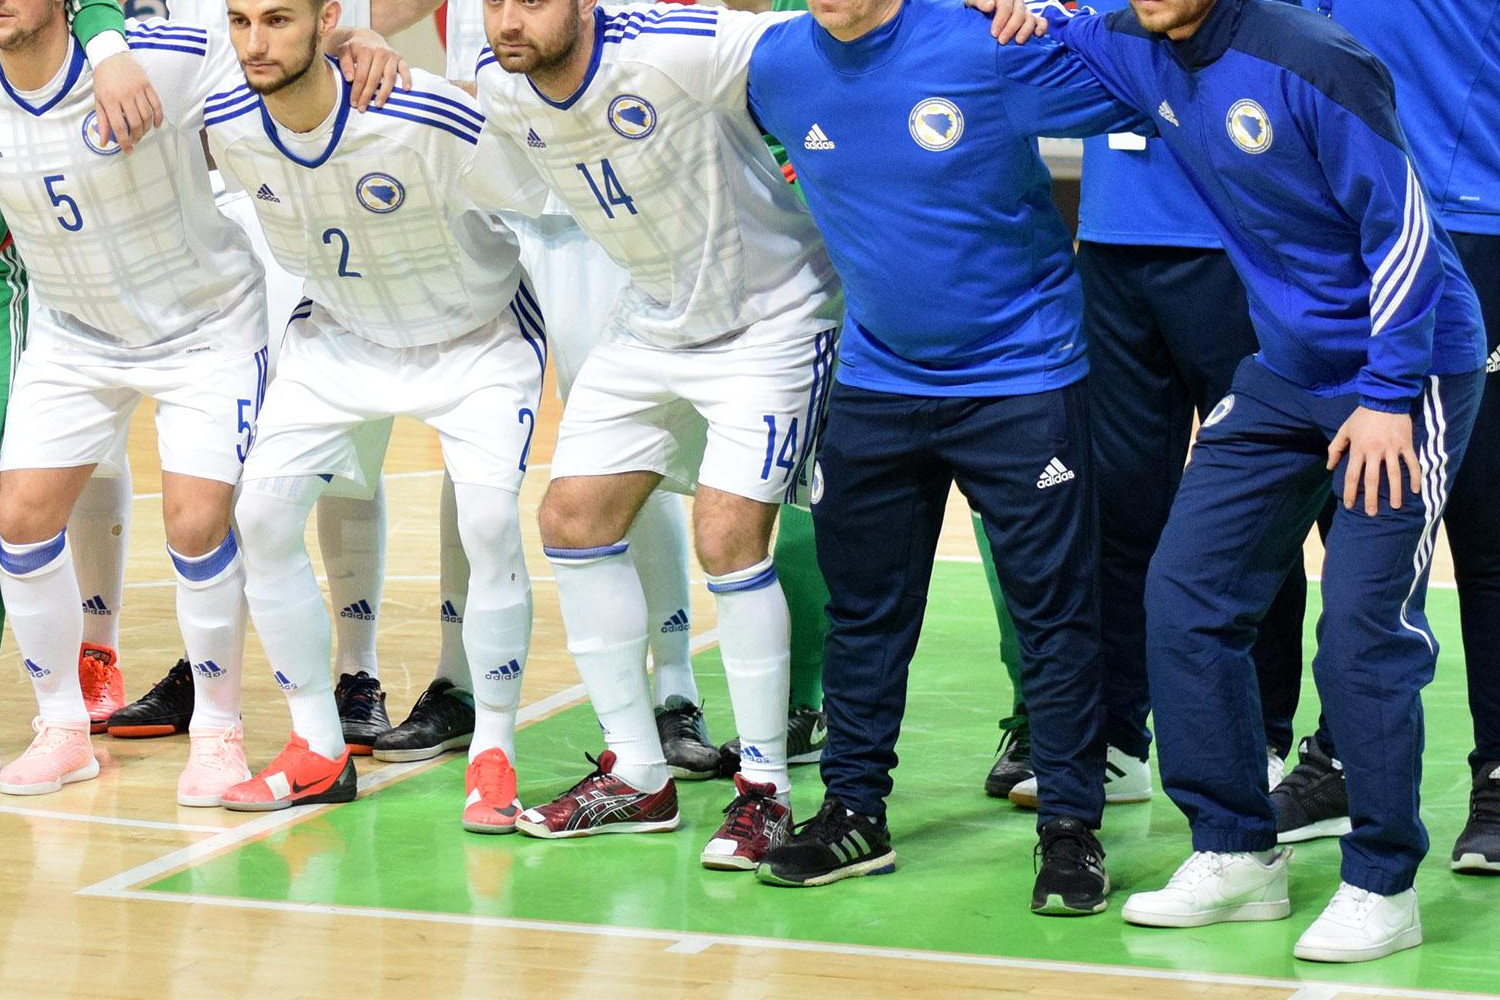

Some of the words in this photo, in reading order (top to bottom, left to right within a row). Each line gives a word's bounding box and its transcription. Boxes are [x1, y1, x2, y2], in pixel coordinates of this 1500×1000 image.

[804, 140, 835, 150] adidas
[43, 174, 84, 232] 5
[576, 158, 638, 219] 14
[322, 227, 362, 278] 2
[236, 399, 252, 464] 5
[518, 407, 535, 473] 2
[760, 415, 799, 483] 14
[1036, 469, 1075, 489] adidas
[82, 606, 112, 616] didas
[340, 608, 376, 621] adidas
